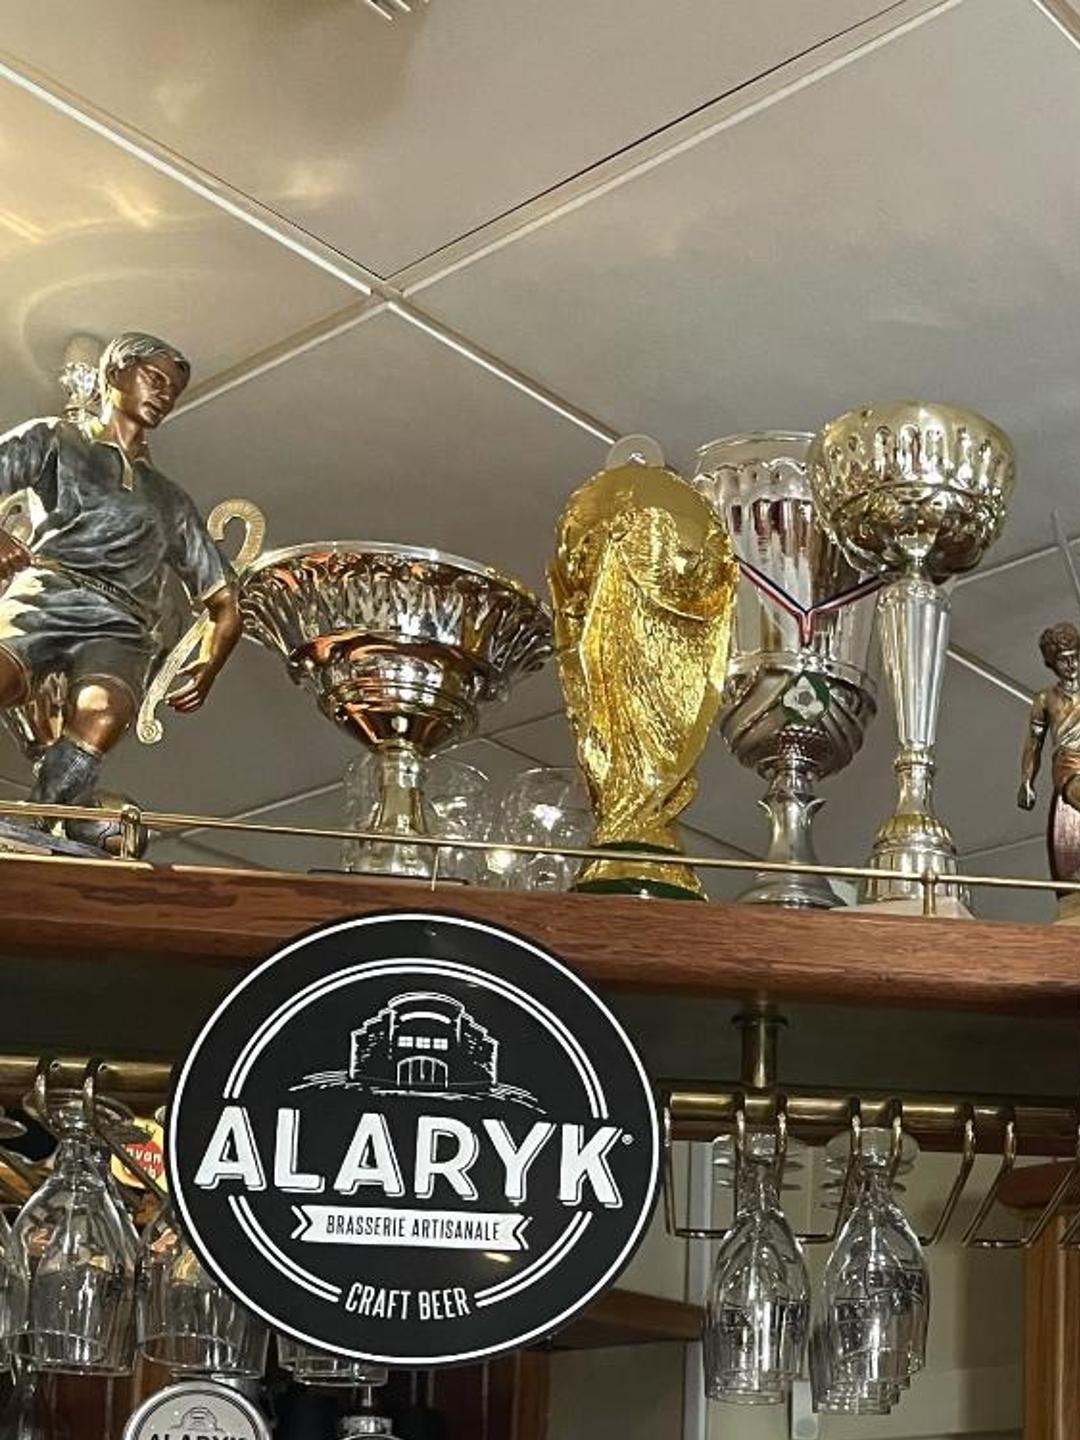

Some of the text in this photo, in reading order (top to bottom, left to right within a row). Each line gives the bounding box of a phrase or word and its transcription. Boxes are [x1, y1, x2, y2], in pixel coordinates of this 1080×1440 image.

[194, 1105, 624, 1209] ALARYK
[325, 1213, 501, 1242] BRASSERIE ARTISANALE
[344, 1281, 472, 1321] CRAFT BEER
